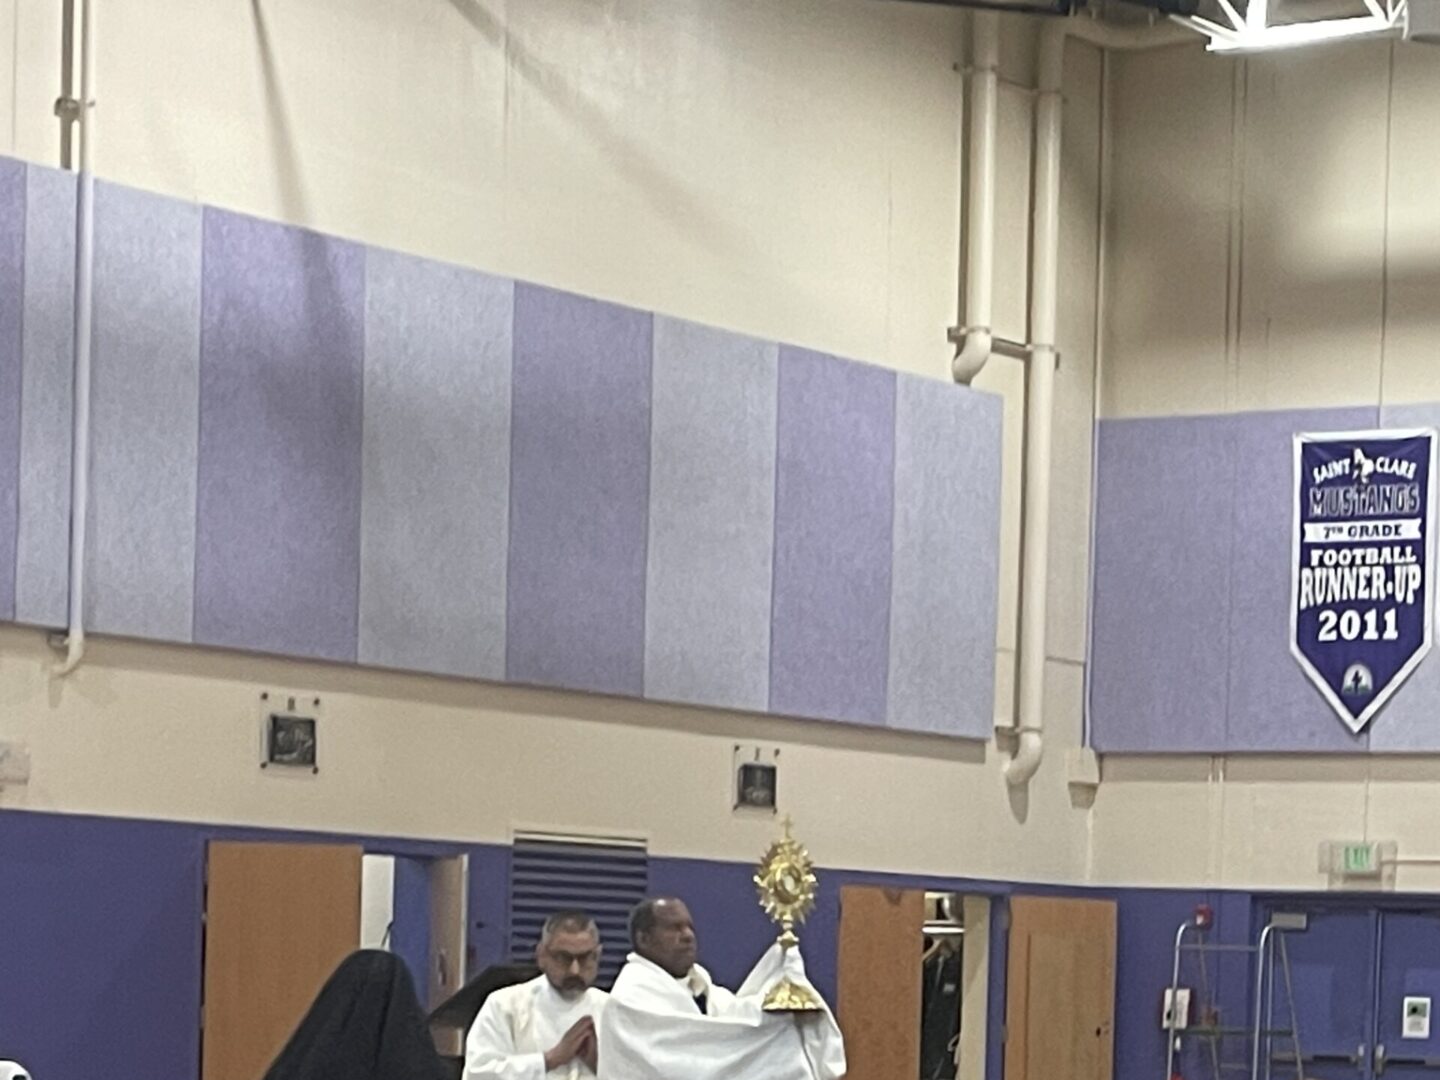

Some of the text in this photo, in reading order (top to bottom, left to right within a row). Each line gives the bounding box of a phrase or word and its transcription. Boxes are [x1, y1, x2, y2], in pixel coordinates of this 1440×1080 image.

[1313, 457, 1417, 484] SAINT CLARE
[1309, 483, 1420, 517] MUSTANGS
[1348, 524, 1402, 537] GRADE
[1311, 546, 1417, 566] FOOTBALL
[1300, 564, 1421, 610] RUNNER-UP
[1318, 608, 1398, 641] 2011
